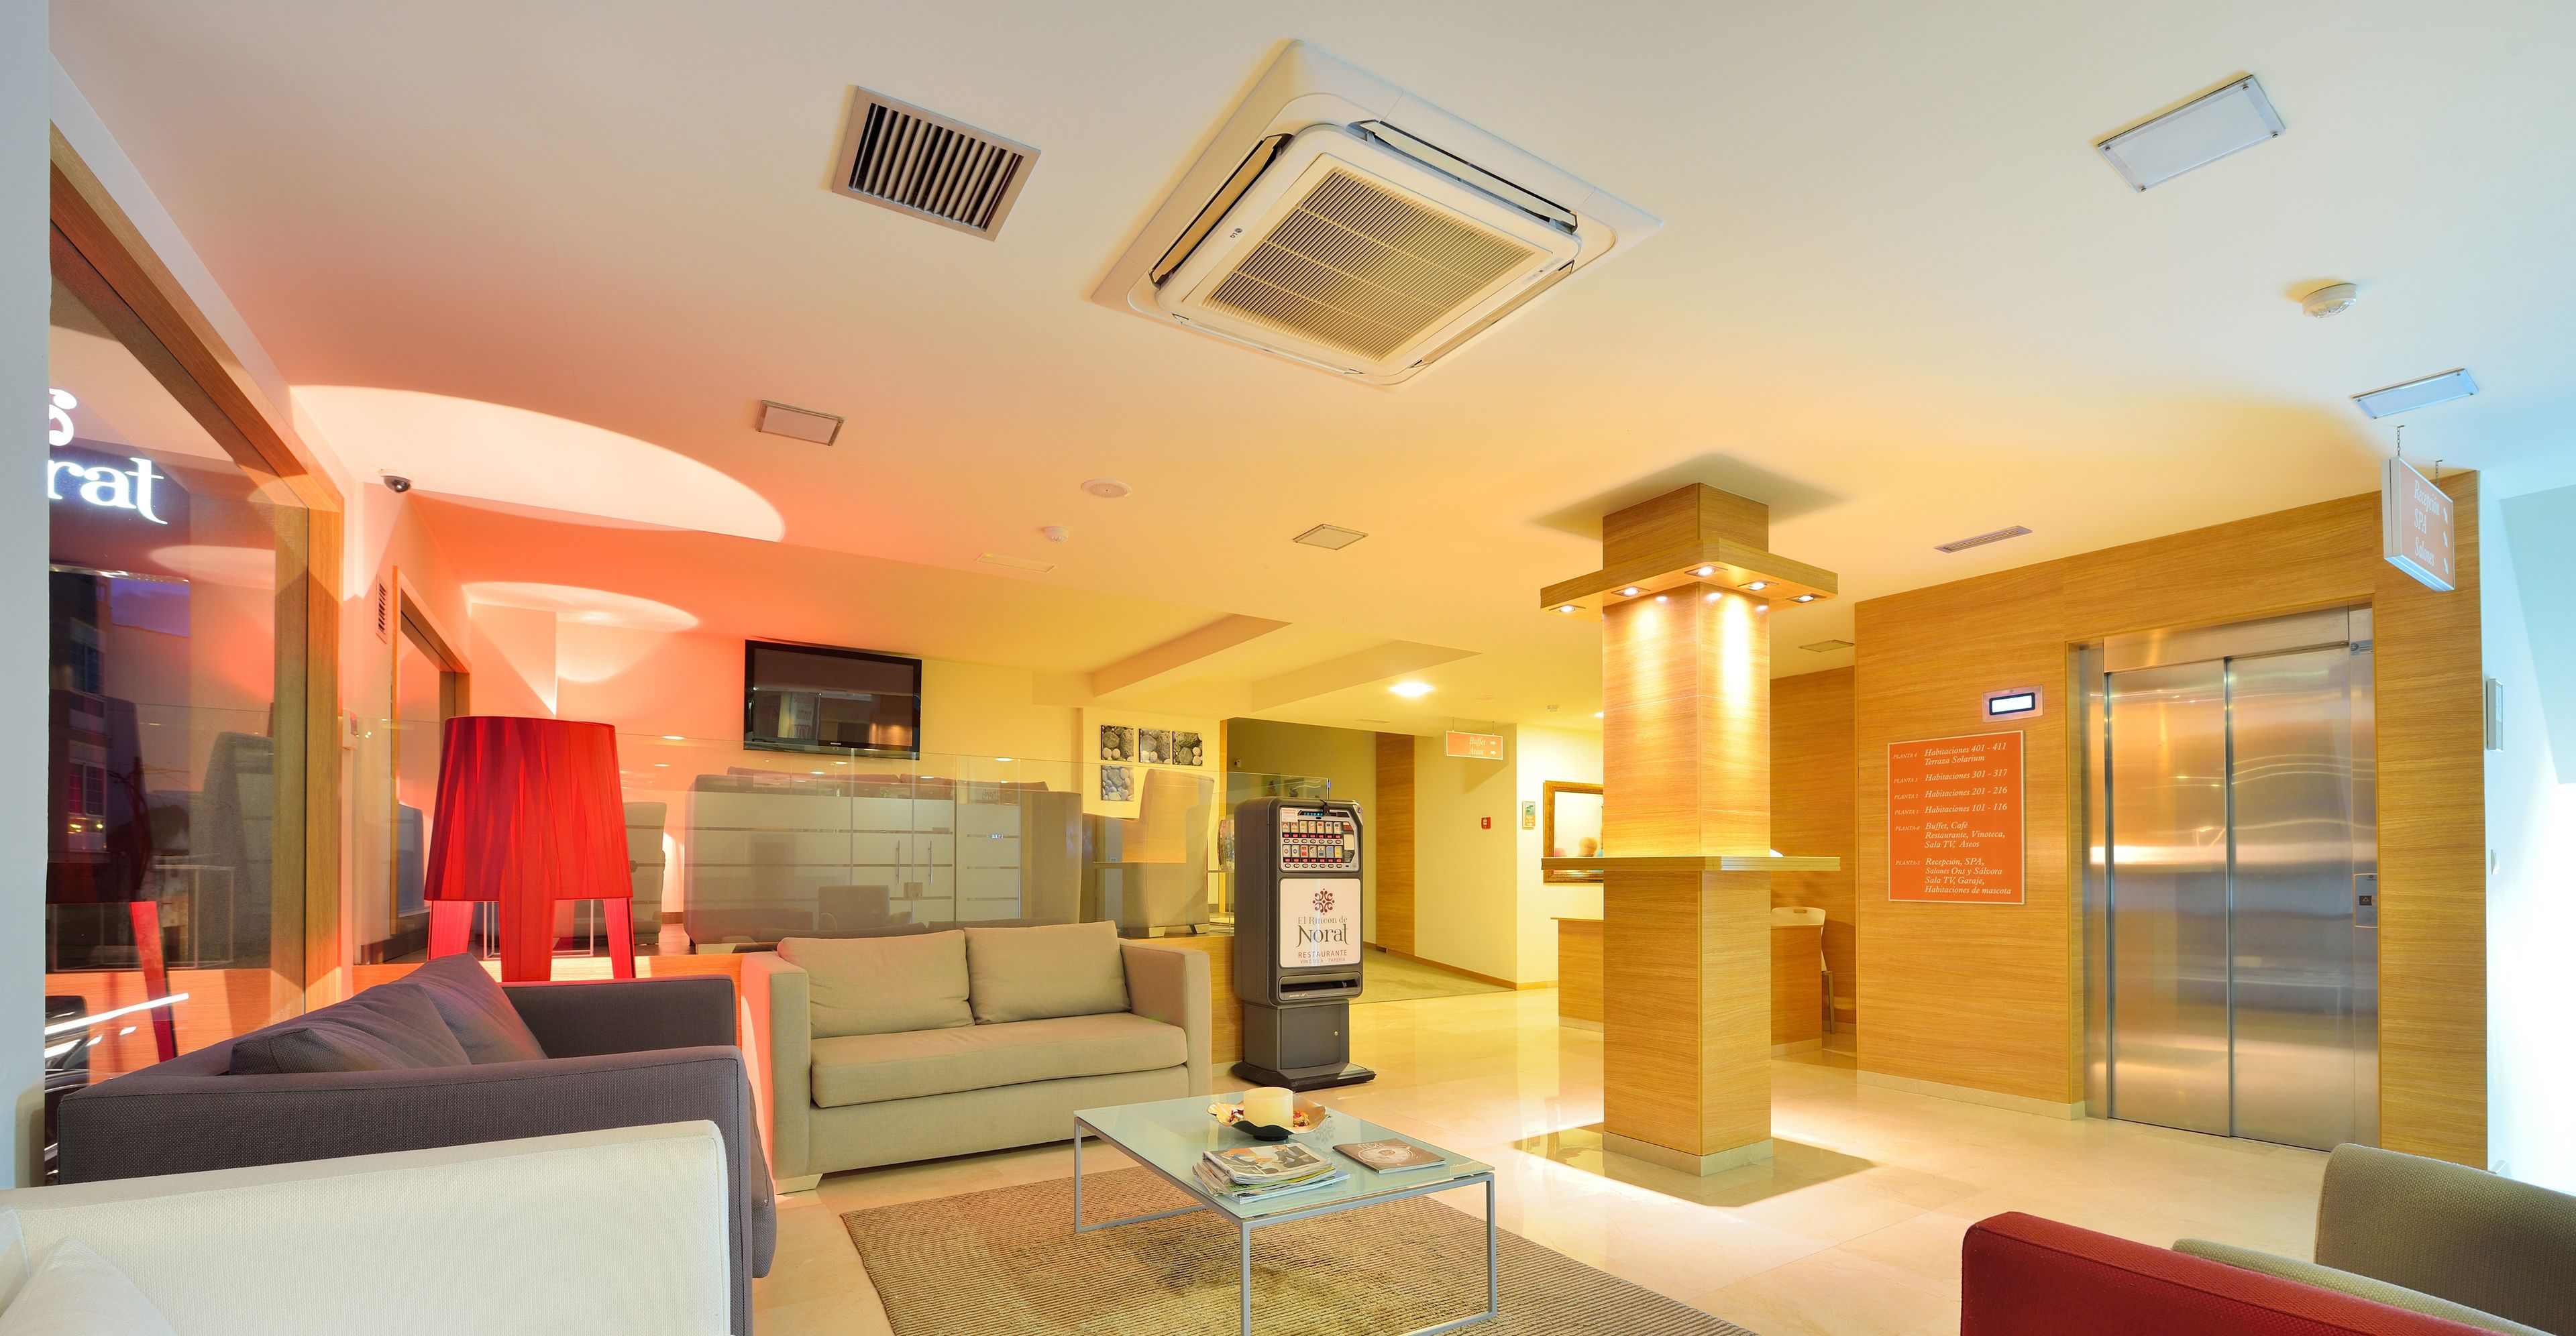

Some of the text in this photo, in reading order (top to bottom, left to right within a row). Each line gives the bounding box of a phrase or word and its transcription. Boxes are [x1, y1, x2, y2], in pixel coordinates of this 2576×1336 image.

[2414, 479, 2440, 516] Recepción
[2414, 508, 2427, 535] SPA
[2414, 536, 2434, 567] Salones
[1469, 736, 1486, 746] Buffet
[1469, 747, 1484, 755] Aseos
[1924, 747, 1970, 757] Habitaciones
[1971, 744, 1985, 753] 401
[1992, 742, 2006, 750] 411
[1924, 755, 1985, 766] Terraza Solarium
[1925, 772, 1970, 781] Habitaciones
[1972, 770, 1986, 779] 301
[1993, 769, 2008, 777] 317
[1925, 789, 1970, 798] Habitaciones
[1972, 787, 1986, 795] 201
[1993, 786, 2008, 794] 216
[1925, 805, 1970, 814] Habitaciones
[1972, 803, 1986, 812] 101
[1993, 803, 2008, 811] 116
[1925, 821, 1968, 831] Buffet, Café
[1925, 830, 2006, 839] Restaurante, Vinoteca,
[1925, 840, 1980, 848] Sala TV, Aseos
[1925, 857, 1985, 867] Recepción, SPA,
[1951, 867, 1966, 875] Ons
[1974, 867, 2002, 875] Sálvora
[1925, 876, 1986, 885] Sala TV, Garaje,
[1925, 885, 1970, 894] Habitaciones
[1971, 886, 1981, 894] de
[1297, 916, 1307, 925] El
[1338, 915, 1348, 924] de
[1294, 923, 1350, 948] Norat
[1298, 949, 1348, 958] RESTAURANTE
